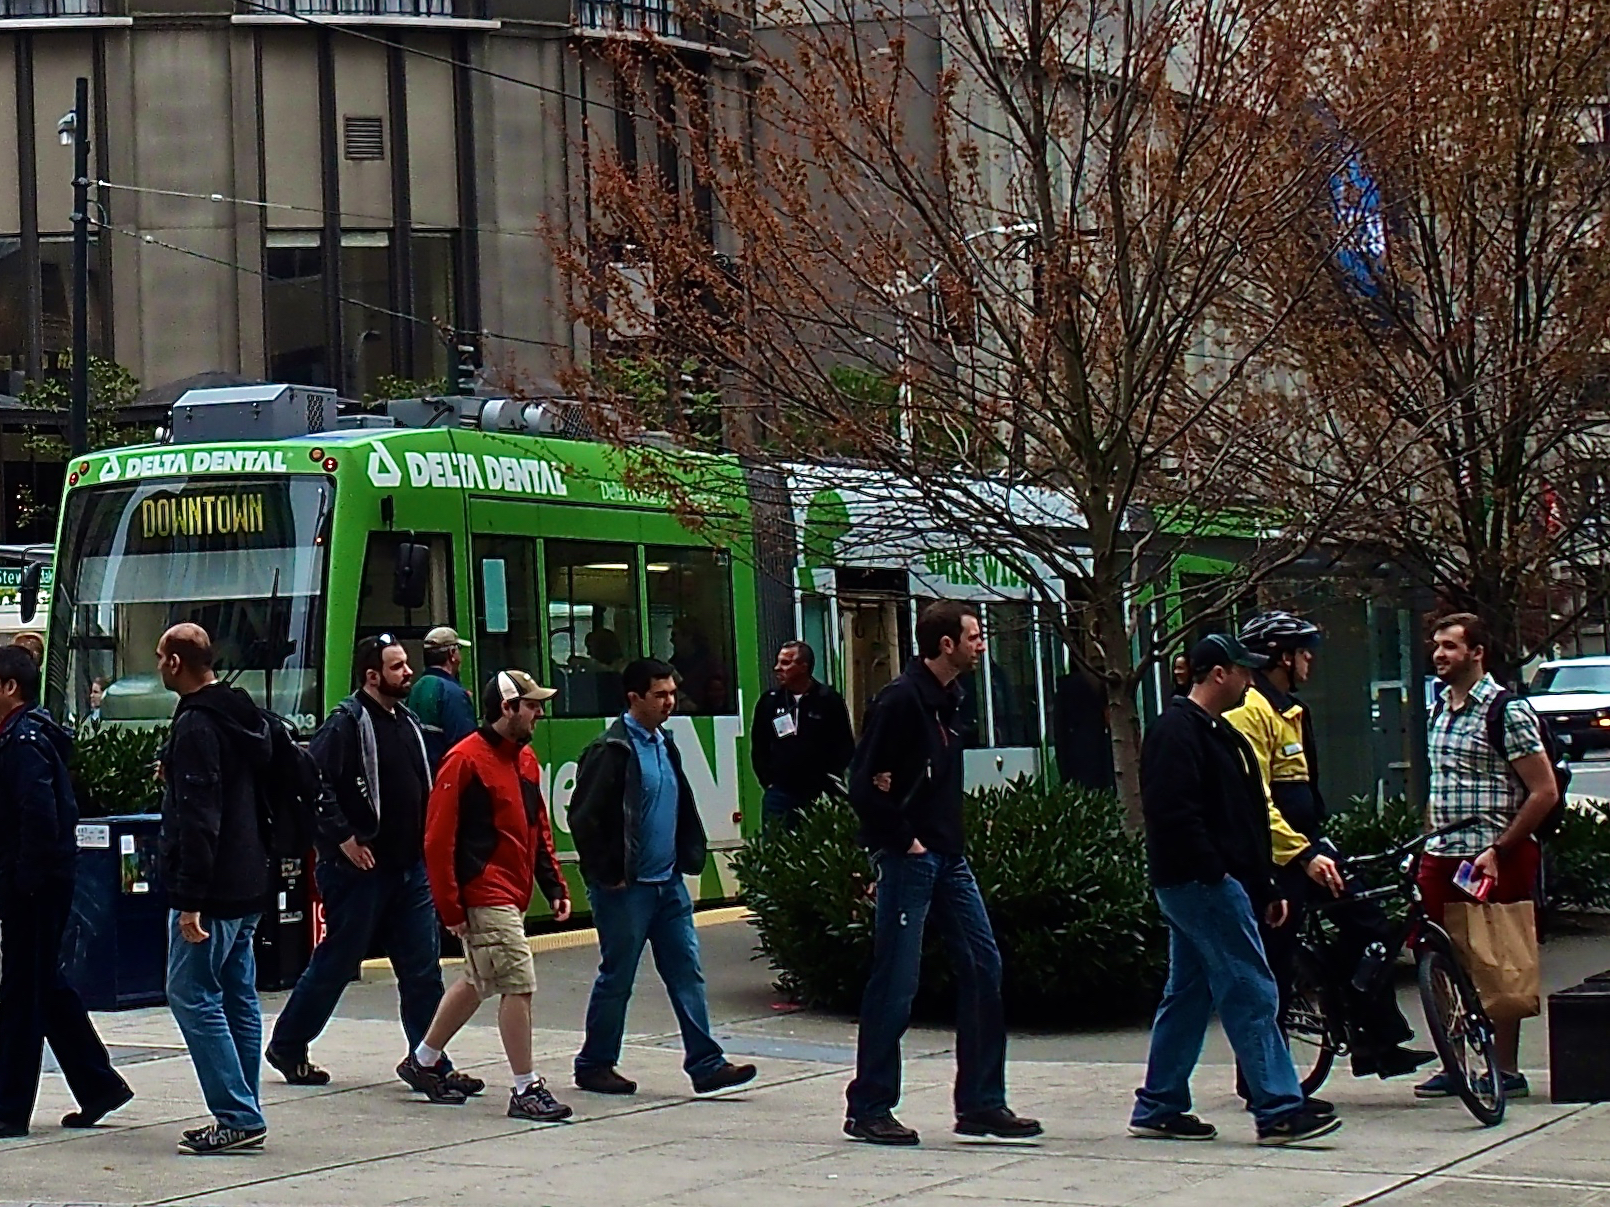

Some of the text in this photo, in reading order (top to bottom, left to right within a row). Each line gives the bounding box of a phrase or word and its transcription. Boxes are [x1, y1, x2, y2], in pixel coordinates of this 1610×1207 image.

[125, 450, 288, 478] DELTA DENTAL
[404, 451, 568, 496] DELTA DENTAL
[142, 494, 264, 538] DOWNTOWN
